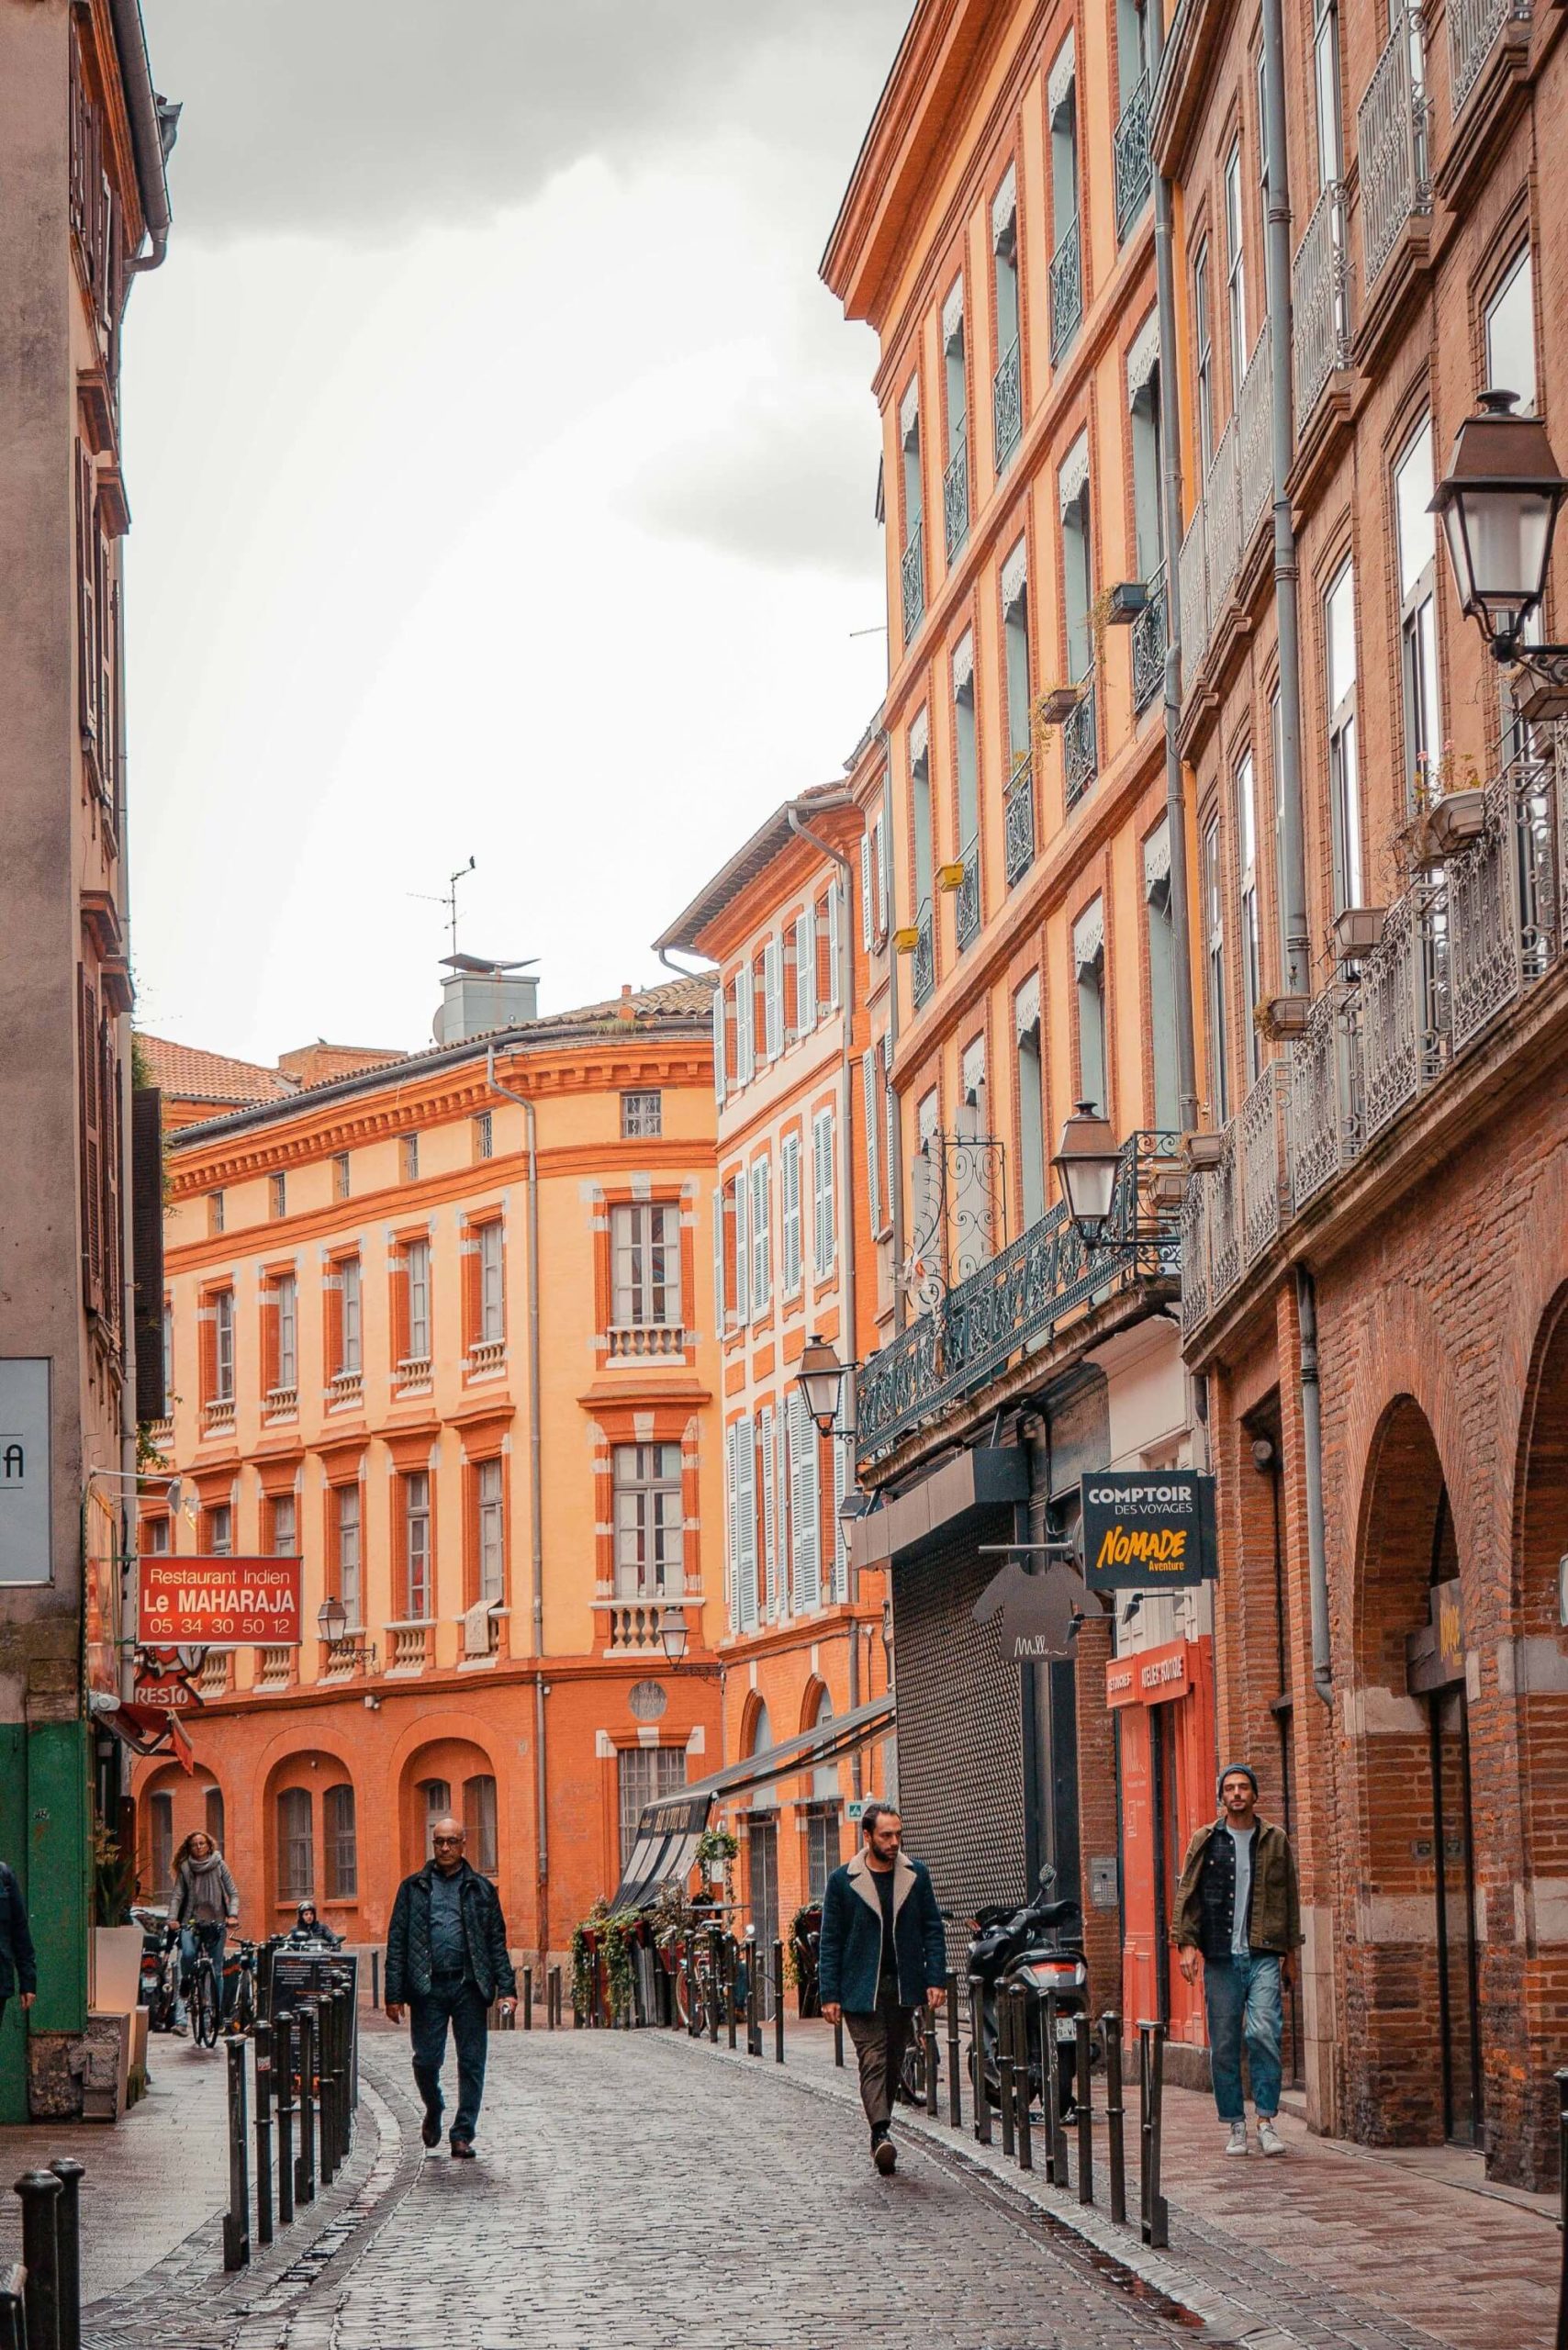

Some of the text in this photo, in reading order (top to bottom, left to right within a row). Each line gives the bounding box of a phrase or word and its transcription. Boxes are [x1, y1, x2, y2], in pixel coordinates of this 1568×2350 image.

[1088, 1485, 1193, 1504] COMPTOIR
[1114, 1502, 1193, 1515] DES VOYAGES
[1096, 1526, 1187, 1568] NOMADE
[1148, 1560, 1186, 1572] Aventure
[150, 1568, 290, 1584] Restaurant Indien
[143, 1588, 296, 1613] Le MAHARAJA
[150, 1617, 290, 1634] 05 34 30 50 12
[135, 1684, 189, 1706] RESTO
